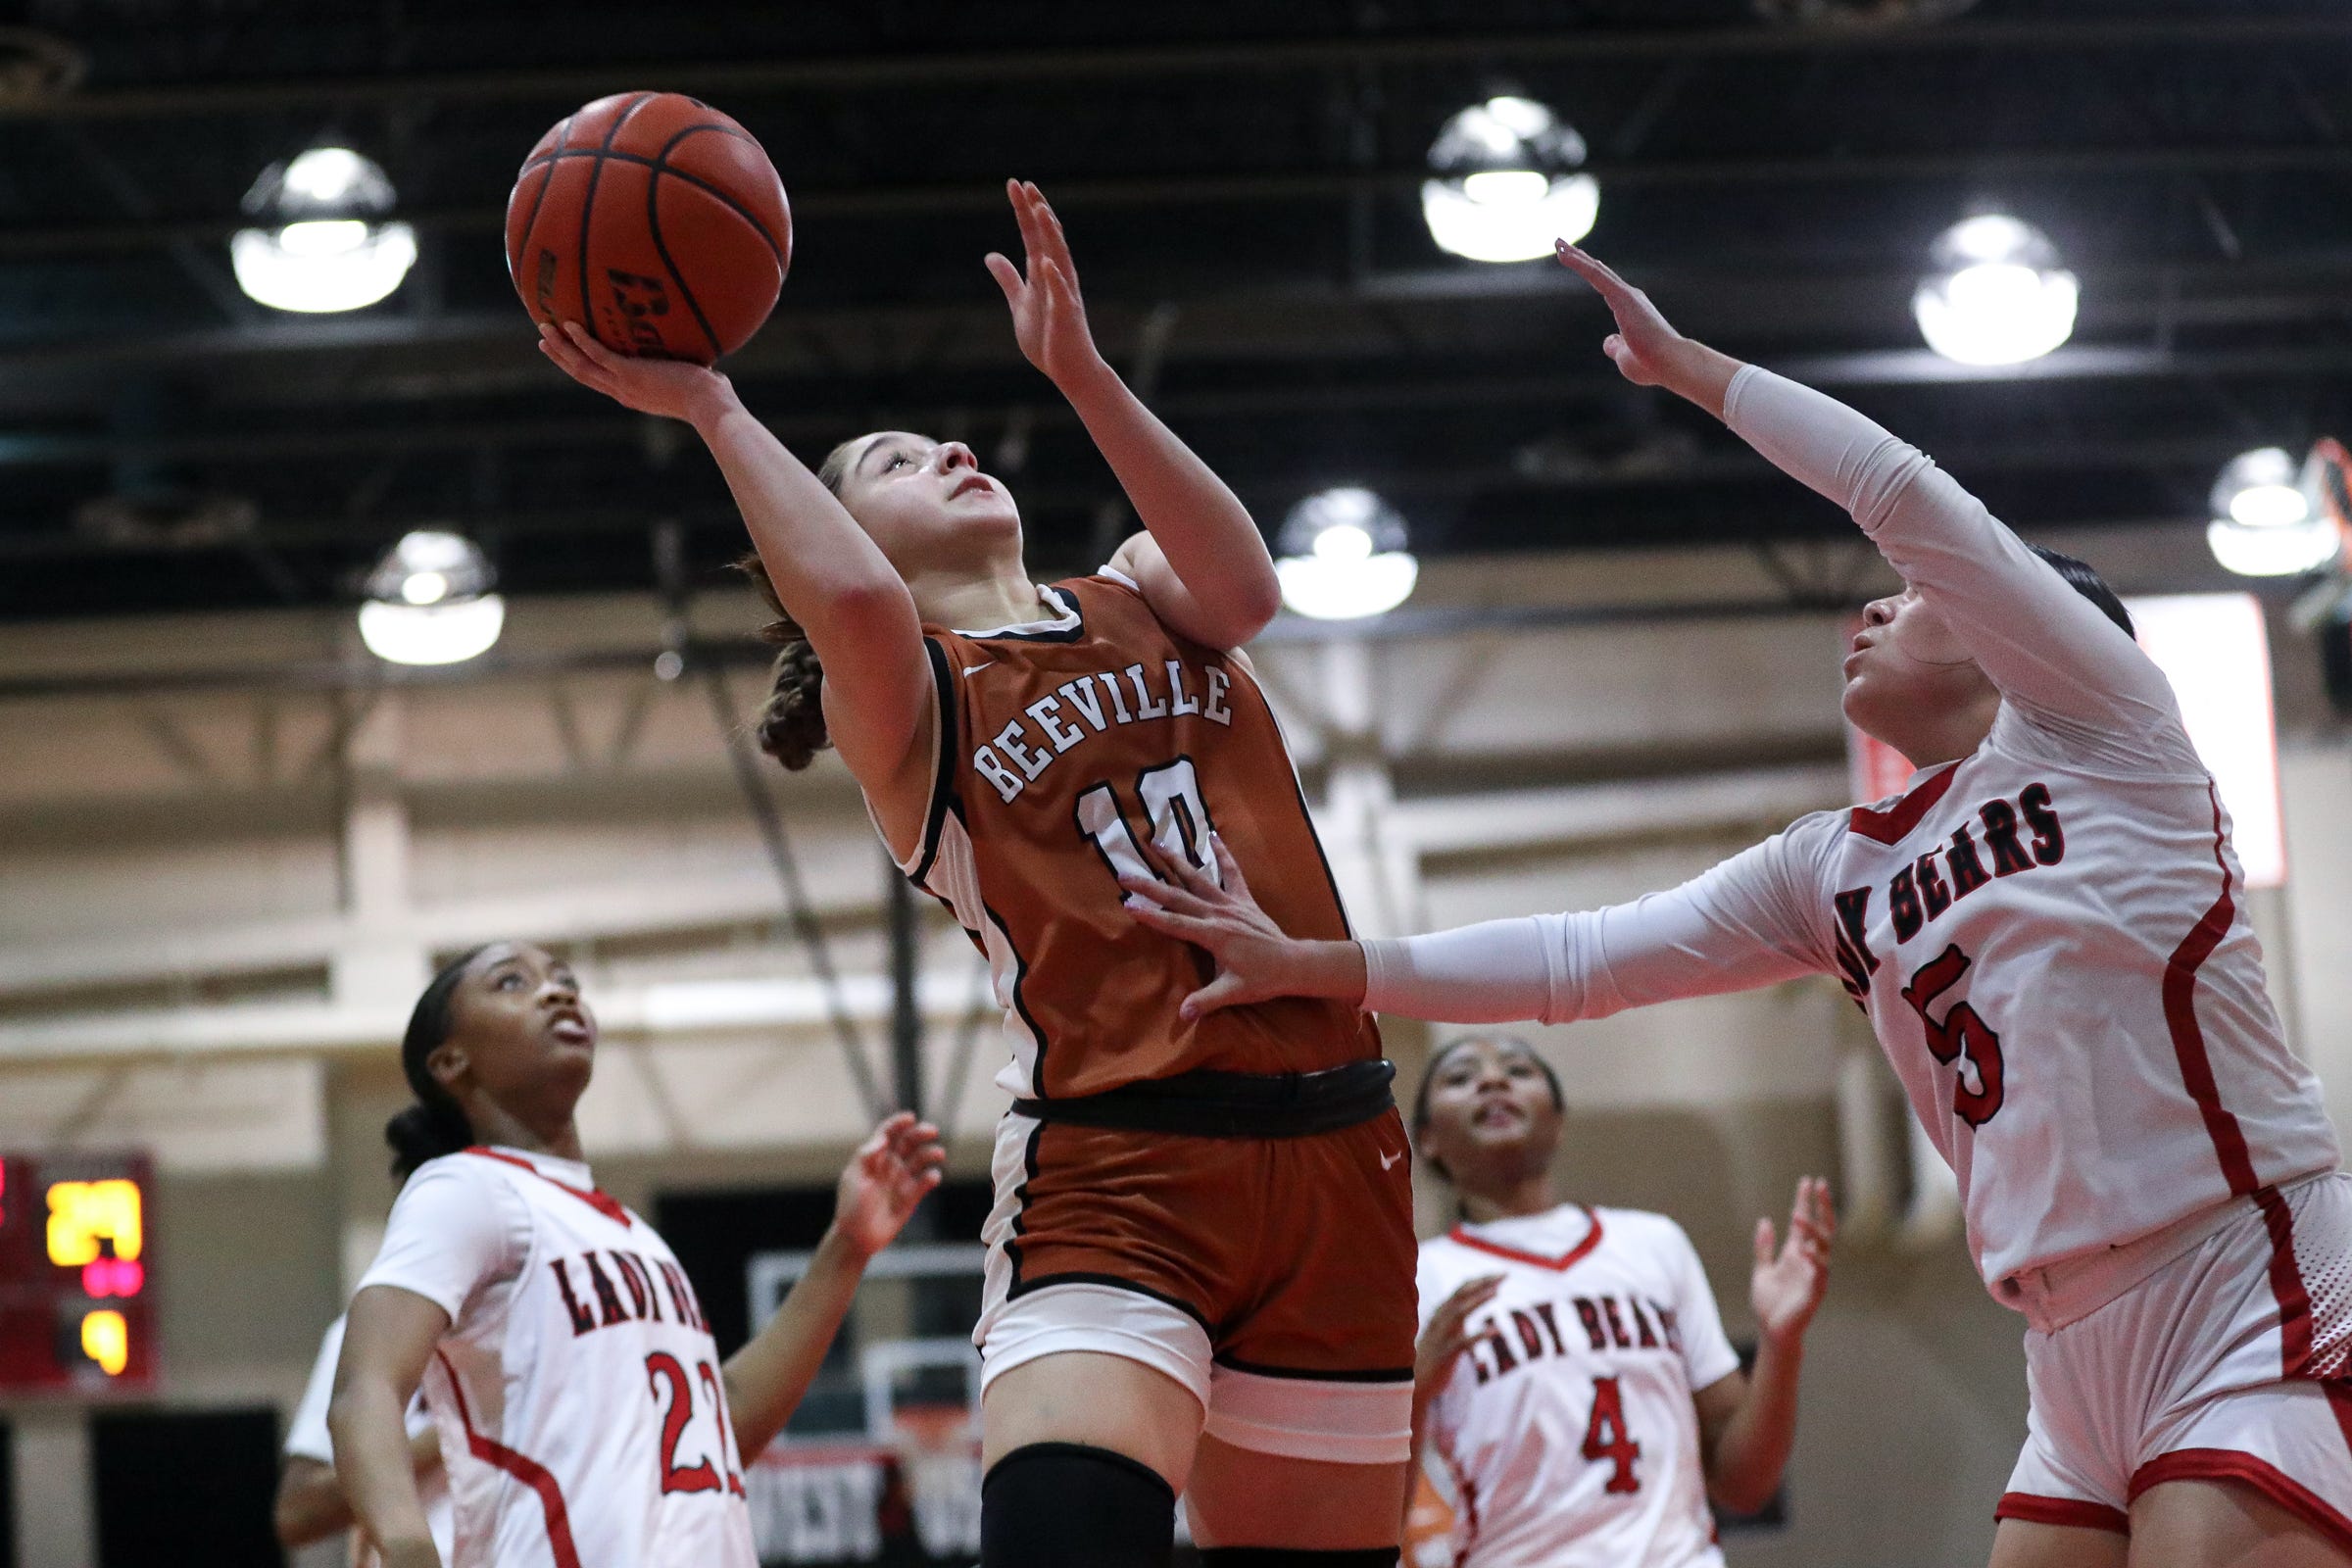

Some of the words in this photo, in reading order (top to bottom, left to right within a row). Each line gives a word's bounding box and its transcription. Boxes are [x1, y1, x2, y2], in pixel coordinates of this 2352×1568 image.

[972, 660, 1233, 806] BEEVILLE
[1072, 753, 1226, 911] 10
[1888, 782, 2066, 945] BEARS
[1900, 943, 2005, 1134] 5
[1580, 1375, 1642, 1496] 4
